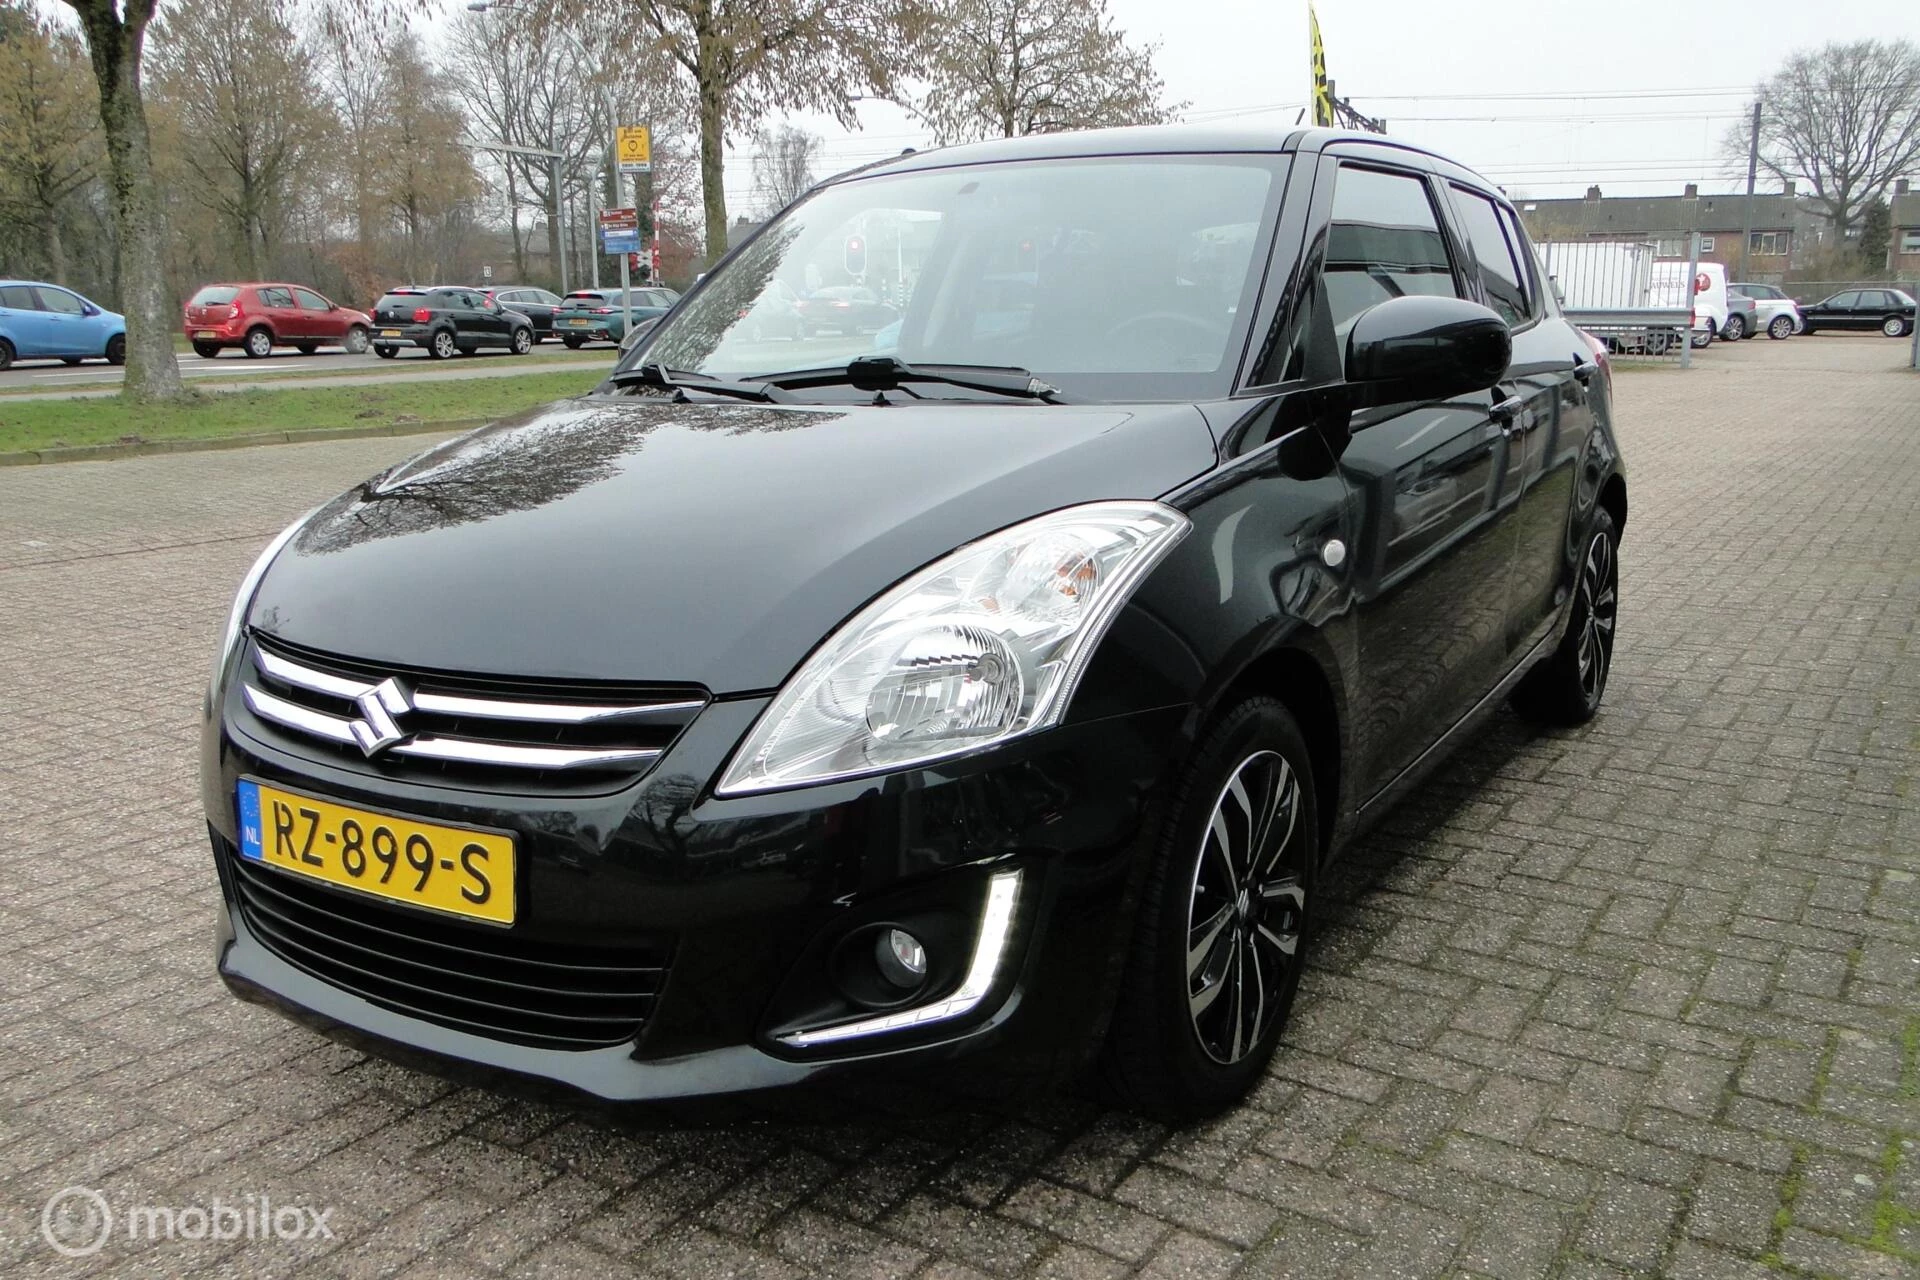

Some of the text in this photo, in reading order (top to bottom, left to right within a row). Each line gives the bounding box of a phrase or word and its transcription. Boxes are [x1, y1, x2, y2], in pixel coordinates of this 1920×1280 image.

[1650, 281, 1686, 289] AUWELS
[246, 799, 491, 905] NL RZ-899-S
